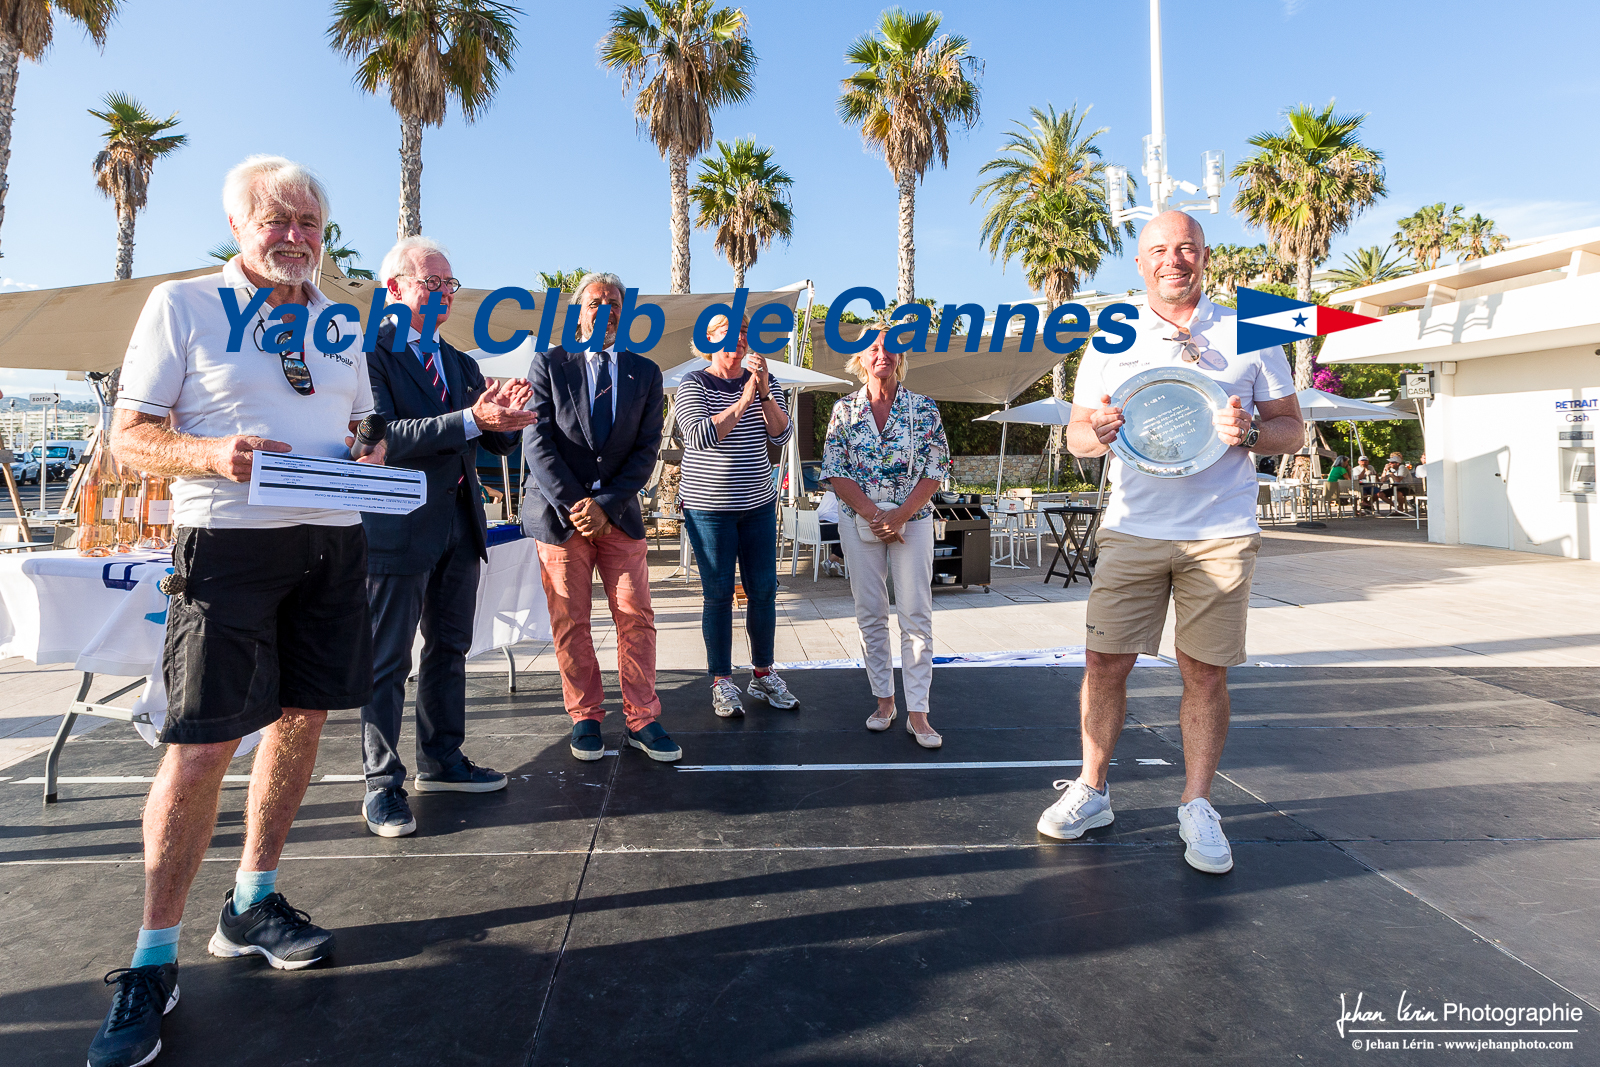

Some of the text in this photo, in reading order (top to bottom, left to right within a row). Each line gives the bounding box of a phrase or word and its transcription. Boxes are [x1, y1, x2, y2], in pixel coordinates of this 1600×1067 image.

[1408, 387, 1429, 395] CASH
[1555, 399, 1597, 409] RETRAIT
[1565, 413, 1589, 422] Cash
